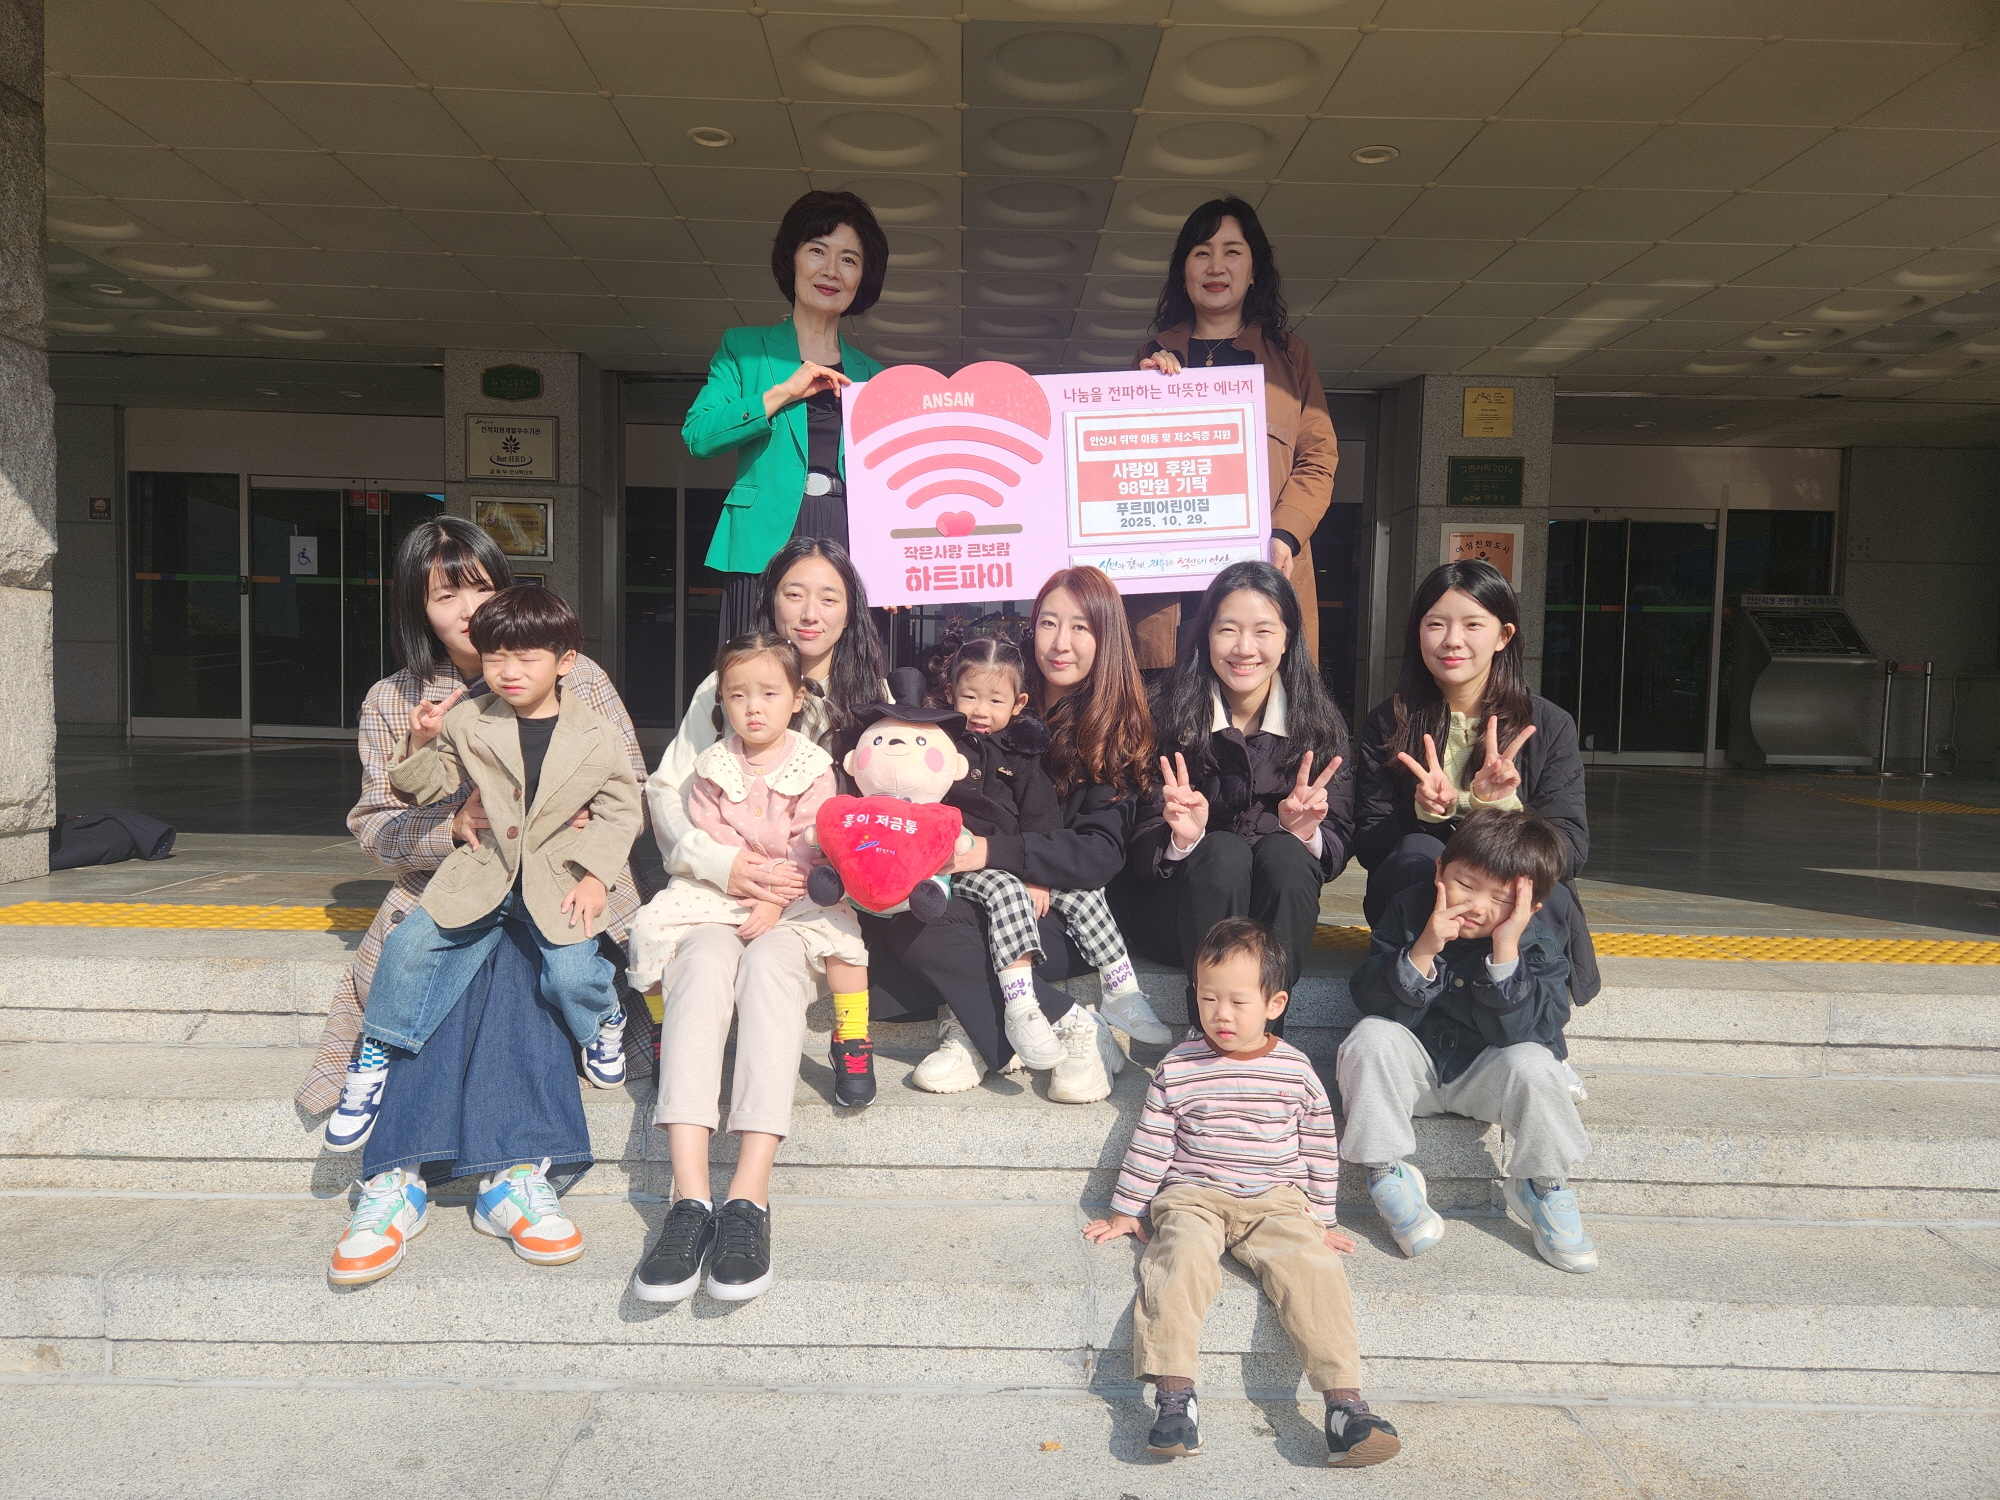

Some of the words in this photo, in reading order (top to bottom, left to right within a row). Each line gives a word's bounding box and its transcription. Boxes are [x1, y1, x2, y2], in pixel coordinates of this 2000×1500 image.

[1063, 387, 1102, 403] 나눔을
[1108, 384, 1162, 401] 전파하는
[1167, 382, 1209, 398] 따뜻한
[1213, 379, 1253, 395] 에너지
[922, 392, 975, 410] ANSAN
[1089, 435, 1117, 447] 안산시
[1119, 434, 1139, 445] 취약
[1140, 433, 1159, 444] 아동
[1161, 432, 1171, 443] 및
[1174, 430, 1210, 442] 저소득층
[1213, 429, 1231, 440] 지원
[1112, 461, 1159, 479] 사랑의
[1165, 458, 1213, 476] 후원금
[1118, 478, 1170, 496] 98만원
[1176, 475, 1208, 493] 기탁
[1116, 498, 1210, 516] 푸르미어린이집
[1120, 516, 1156, 528] 2025.
[1162, 515, 1182, 526] 10.
[1186, 514, 1207, 525] 29.
[904, 544, 963, 560] 작은사랑
[967, 542, 1011, 558] 큰보람
[1209, 554, 1232, 565] 안산
[905, 562, 1013, 592] 하트파이
[875, 814, 919, 834] 저금통
